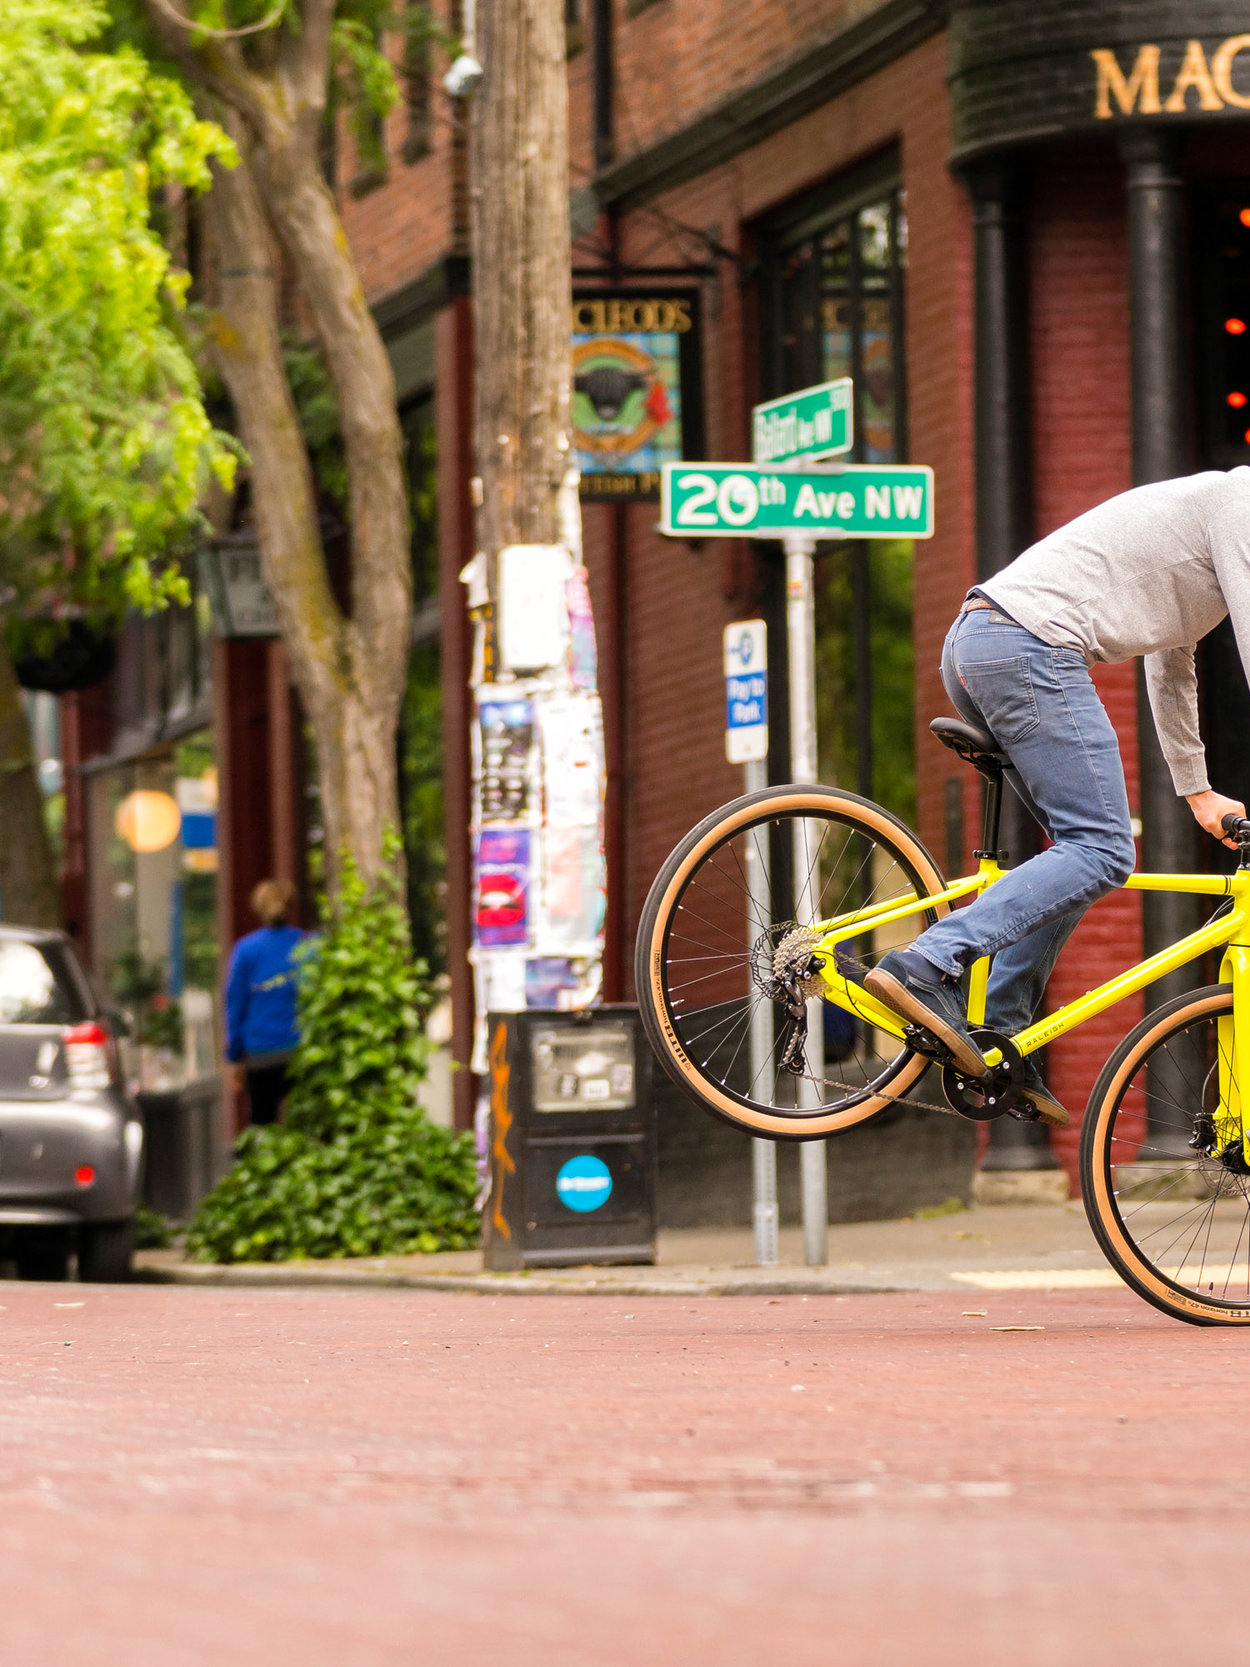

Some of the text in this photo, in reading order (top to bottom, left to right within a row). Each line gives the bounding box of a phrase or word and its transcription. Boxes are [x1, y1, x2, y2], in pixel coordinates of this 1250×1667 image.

[677, 473, 786, 526] 20th
[793, 484, 856, 518] Ave
[864, 485, 924, 519] NW
[1026, 1023, 1065, 1047] RALEIGH
